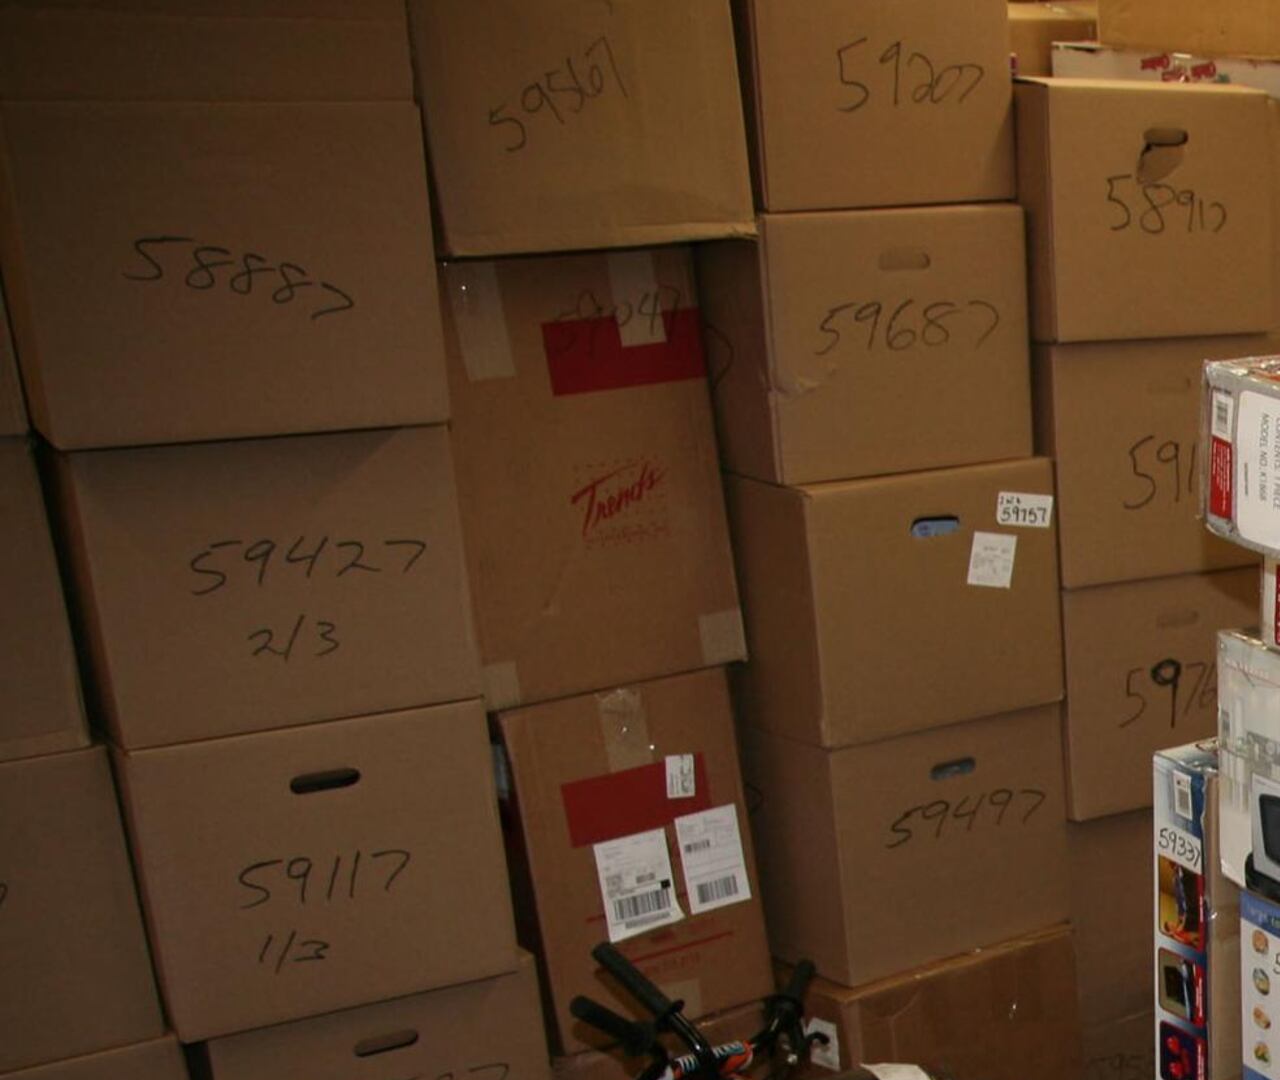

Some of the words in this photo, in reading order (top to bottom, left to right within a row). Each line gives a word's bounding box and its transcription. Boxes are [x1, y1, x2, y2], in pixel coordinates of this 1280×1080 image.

[190, 535, 427, 596] 59427
[248, 614, 341, 660] 2/3
[886, 789, 1046, 849] 59497
[239, 851, 411, 909] 59117
